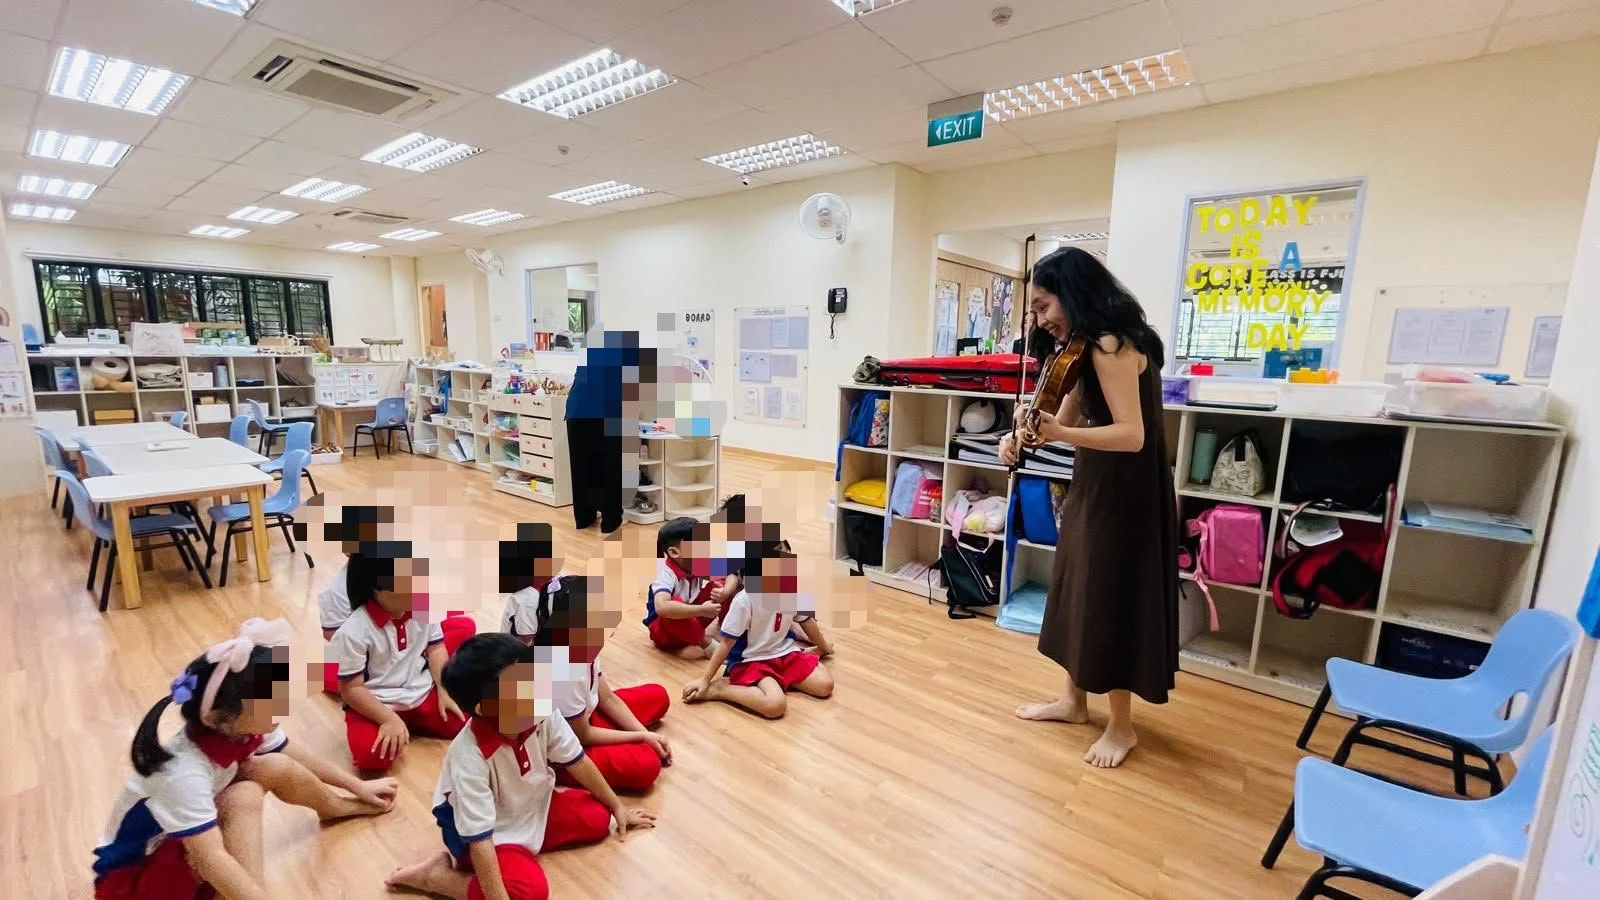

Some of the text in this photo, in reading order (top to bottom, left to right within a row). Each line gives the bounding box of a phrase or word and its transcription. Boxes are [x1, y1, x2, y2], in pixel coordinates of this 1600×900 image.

[943, 116, 976, 140] EXIT
[1230, 229, 1302, 272] IS A
[1186, 259, 1269, 290] CORE
[1300, 269, 1316, 279] IS
[685, 312, 711, 323] BOARD
[1197, 288, 1332, 318] MEMORY
[1247, 322, 1311, 352] DAY
